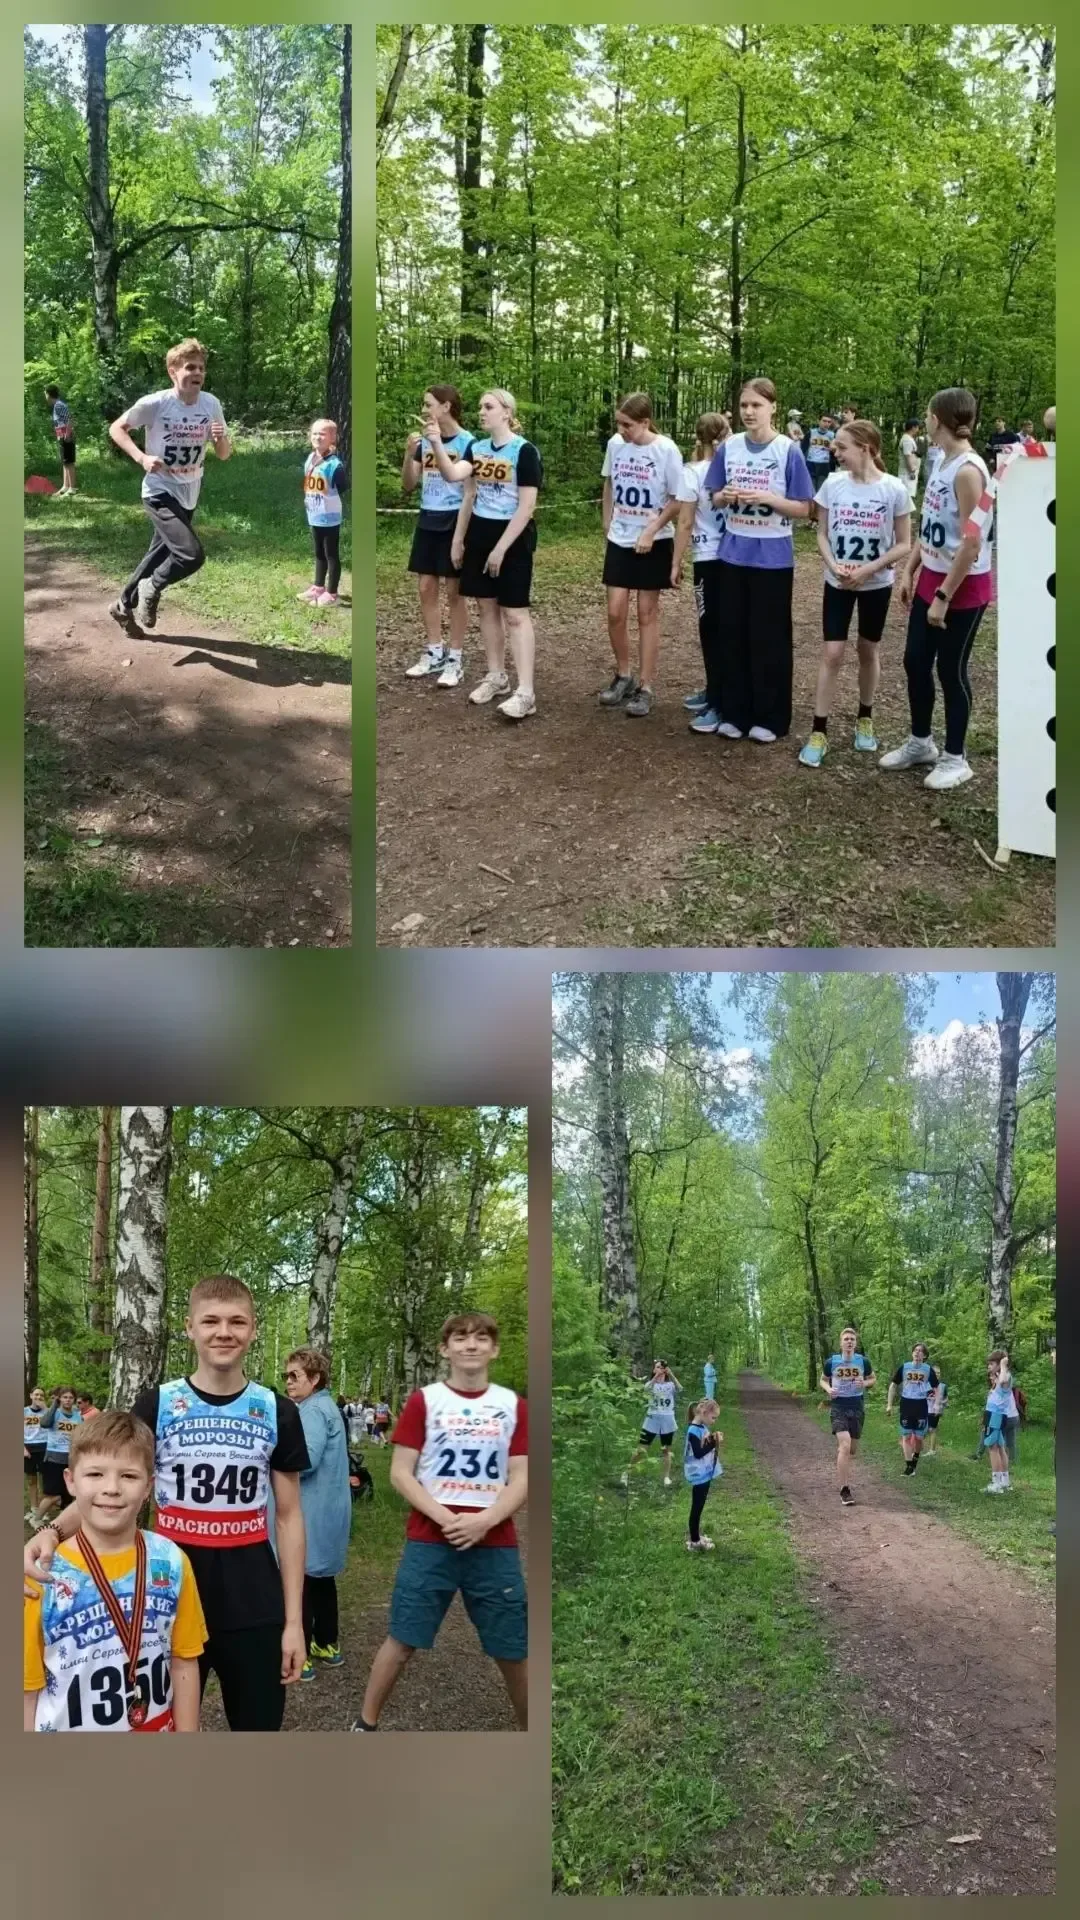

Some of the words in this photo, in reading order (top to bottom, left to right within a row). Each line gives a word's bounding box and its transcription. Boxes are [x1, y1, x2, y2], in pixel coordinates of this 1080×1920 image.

[163, 445, 202, 466] 537
[472, 460, 506, 480] 256
[735, 468, 771, 477] КРАСНО
[734, 476, 769, 486] ГОРСКИЙ
[615, 484, 654, 509] 201
[840, 508, 881, 520] КРАСНО
[840, 519, 881, 529] ГОРСКИЙ
[837, 1368, 859, 1378] 335
[907, 1372, 925, 1382] 332
[164, 1417, 271, 1440] КРЕЩЕНСКИЕ
[448, 1418, 499, 1427] КРАСНО
[182, 1431, 253, 1448] МОРОЗЫ
[194, 1449, 227, 1459] Сергея
[436, 1448, 500, 1479] 236
[171, 1463, 259, 1504] 1349
[158, 1513, 266, 1536] КРАСНОГОРСК
[67, 1653, 171, 1729] 1350
